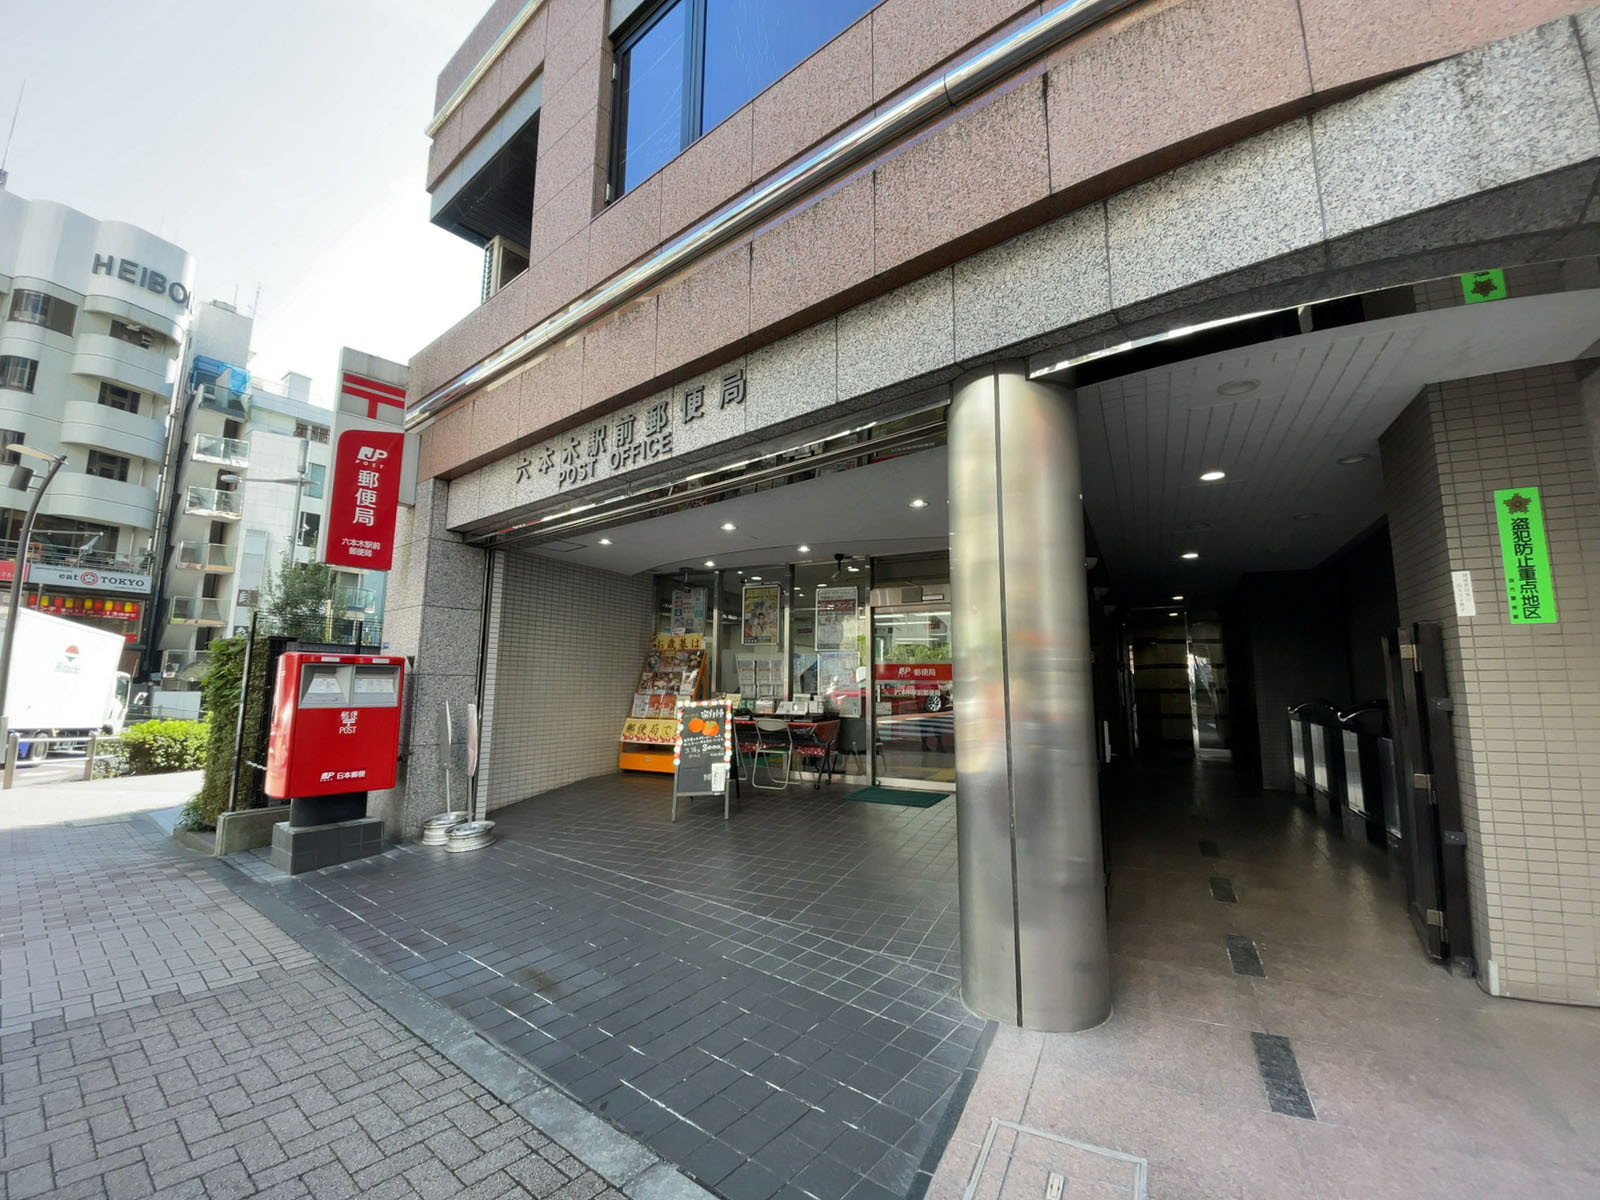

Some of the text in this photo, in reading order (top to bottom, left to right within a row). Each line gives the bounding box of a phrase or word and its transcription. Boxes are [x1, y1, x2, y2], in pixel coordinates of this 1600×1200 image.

[516, 368, 746, 484] 六本木駅前郵便局
[558, 430, 673, 488] POST OFFICE
[352, 470, 379, 527] 郵便局
[341, 537, 381, 551] 六本木駅前
[1510, 517, 1542, 619] 盗犯防止重点地区
[100, 576, 145, 587] TOKYO
[339, 726, 357, 734] POST
